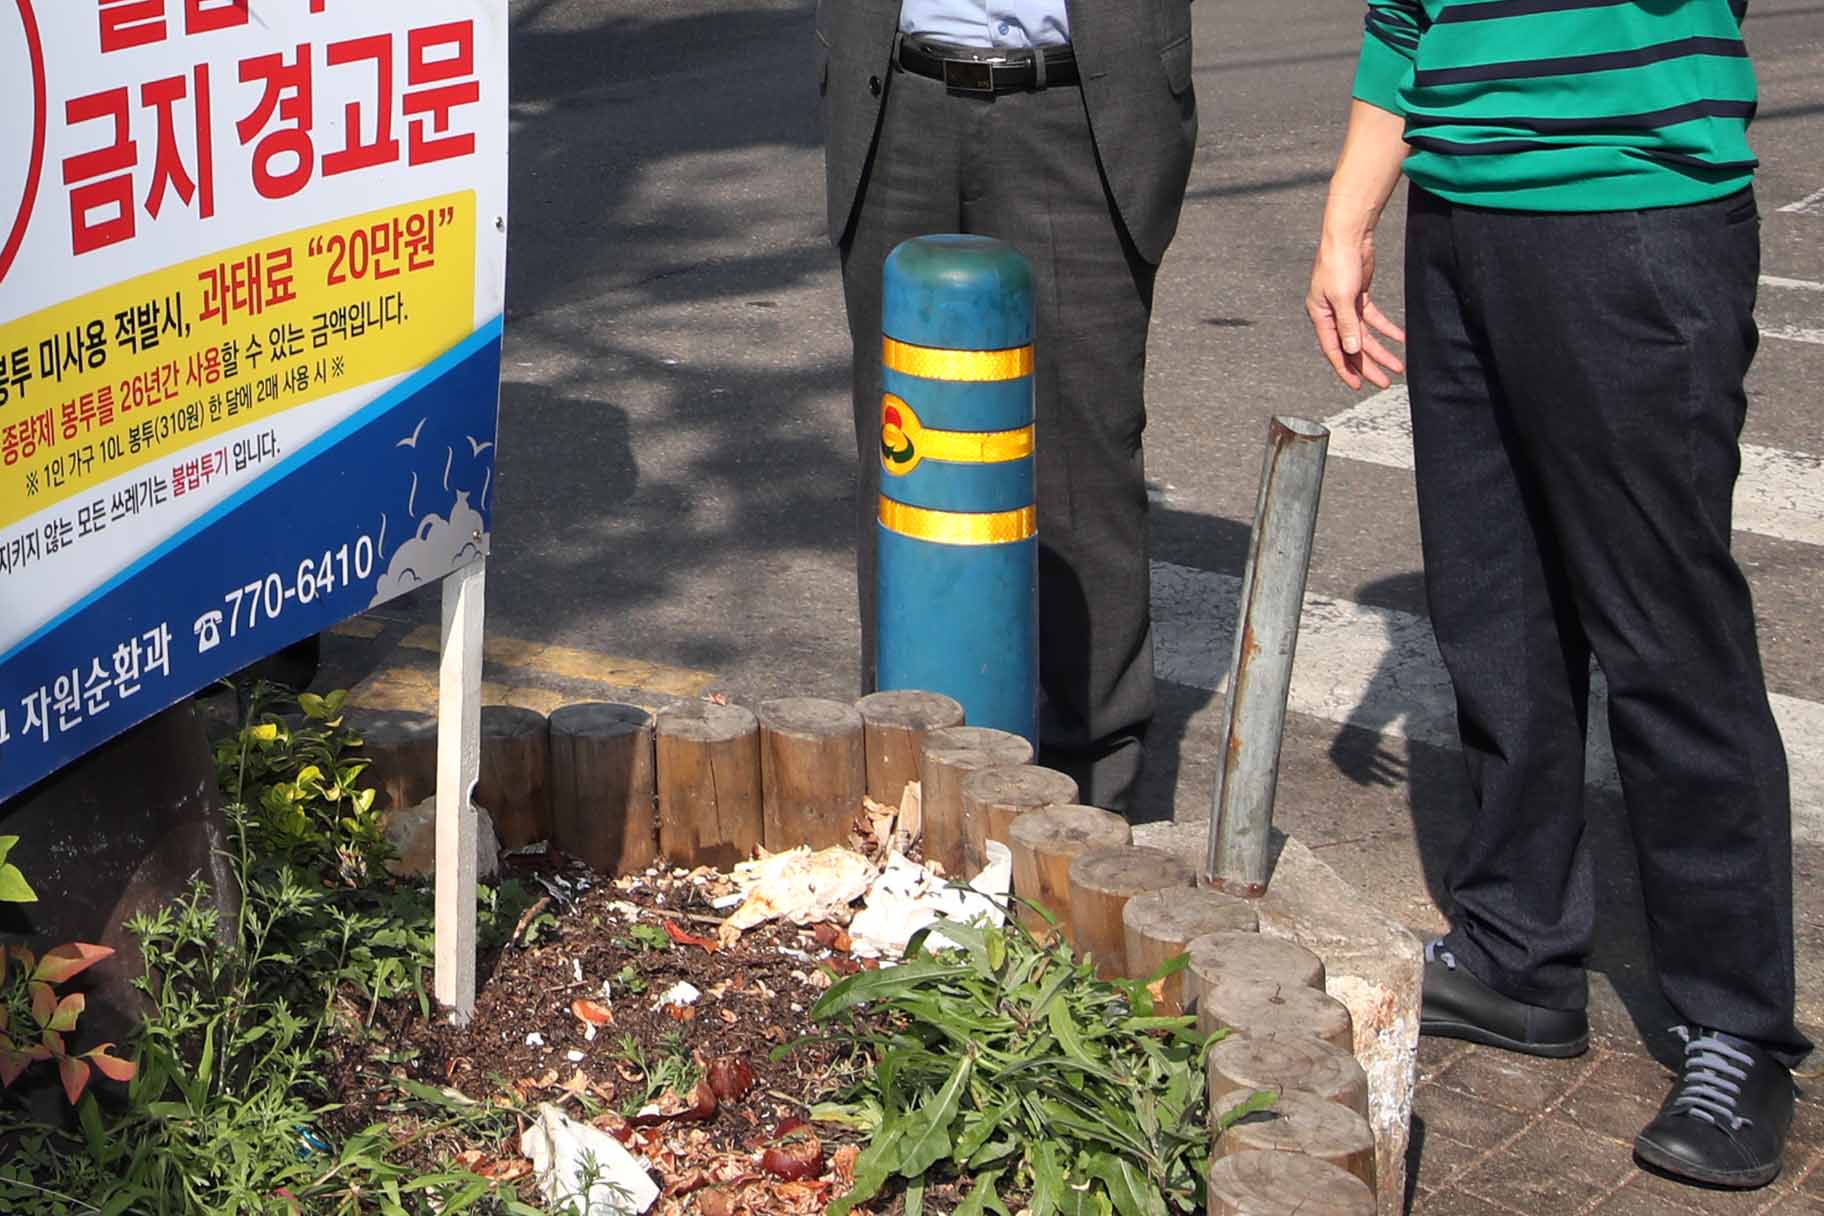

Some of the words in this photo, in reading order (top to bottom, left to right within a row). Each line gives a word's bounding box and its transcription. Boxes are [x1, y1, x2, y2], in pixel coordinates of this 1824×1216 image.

[62, 63, 214, 256] 금지
[236, 19, 480, 199] 경고문
[1, 407, 56, 466] 종량제
[61, 385, 115, 440] 봉투를
[120, 360, 180, 412] 26년간
[186, 340, 239, 386] 사용할
[245, 334, 264, 369] 수
[268, 322, 305, 364] 있는
[311, 291, 409, 349] 금액입니다.
[39, 319, 107, 383] 미사용
[114, 291, 191, 354] 적발시,
[198, 247, 296, 325] 과태료
[44, 455, 65, 488] 1인
[69, 445, 95, 477] 가구
[100, 438, 124, 464] 10L
[208, 397, 223, 423] 한
[226, 384, 253, 417] 달에
[256, 376, 279, 404] 2매
[282, 365, 309, 394] 사용
[314, 357, 328, 385] 시
[45, 517, 74, 557] 않는
[77, 499, 107, 537] 모든
[110, 475, 168, 522] 쓰레기는
[171, 446, 229, 498] 불법투기
[232, 429, 281, 473] 입니다.
[21, 621, 173, 744] 자원순환과
[225, 535, 374, 639] 770-6410
